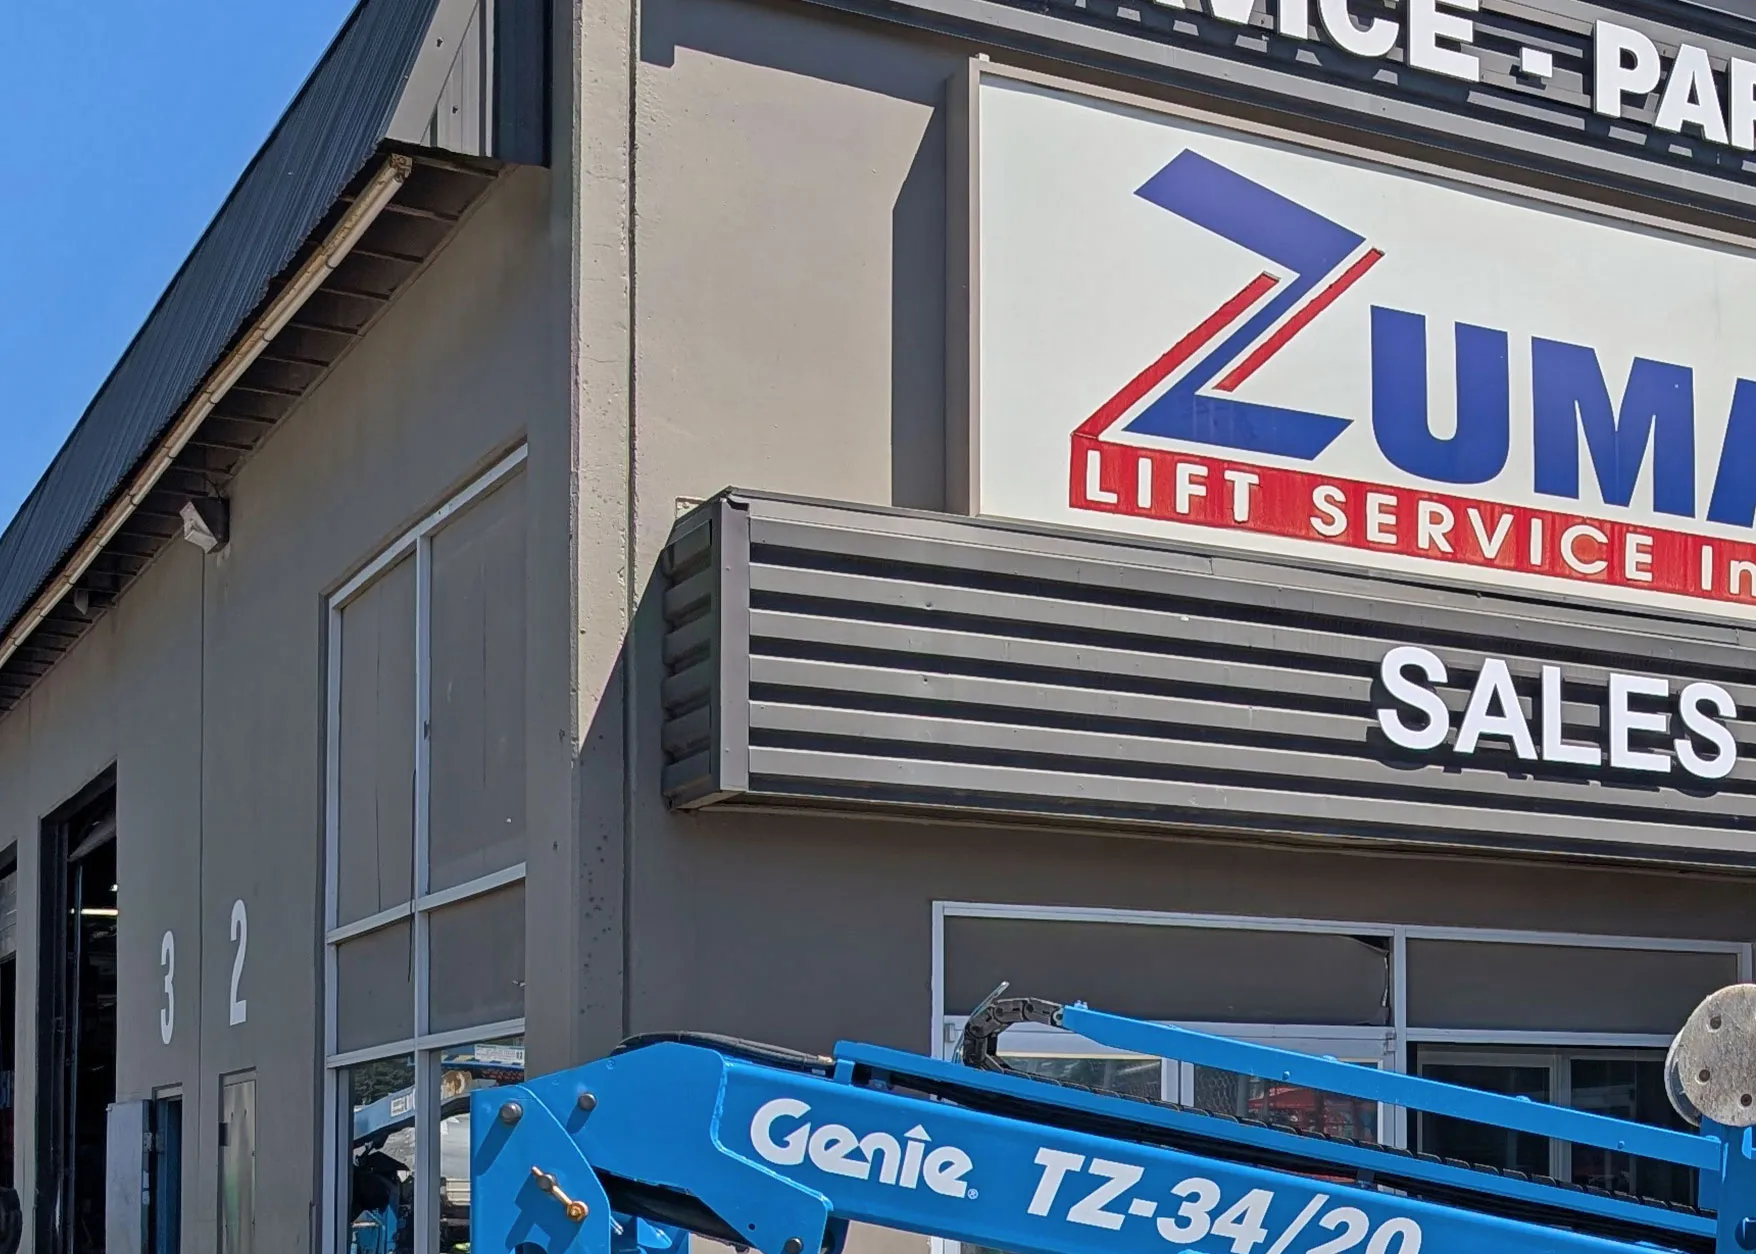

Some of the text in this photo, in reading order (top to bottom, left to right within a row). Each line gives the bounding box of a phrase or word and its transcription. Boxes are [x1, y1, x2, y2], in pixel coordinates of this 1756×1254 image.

[1085, 448, 1261, 523] LIFT
[1312, 484, 1655, 583] SERVICE
[1378, 645, 1738, 780] SALES
[160, 930, 175, 1045] 3
[230, 898, 248, 1026] 2
[750, 1097, 974, 1199] Genie
